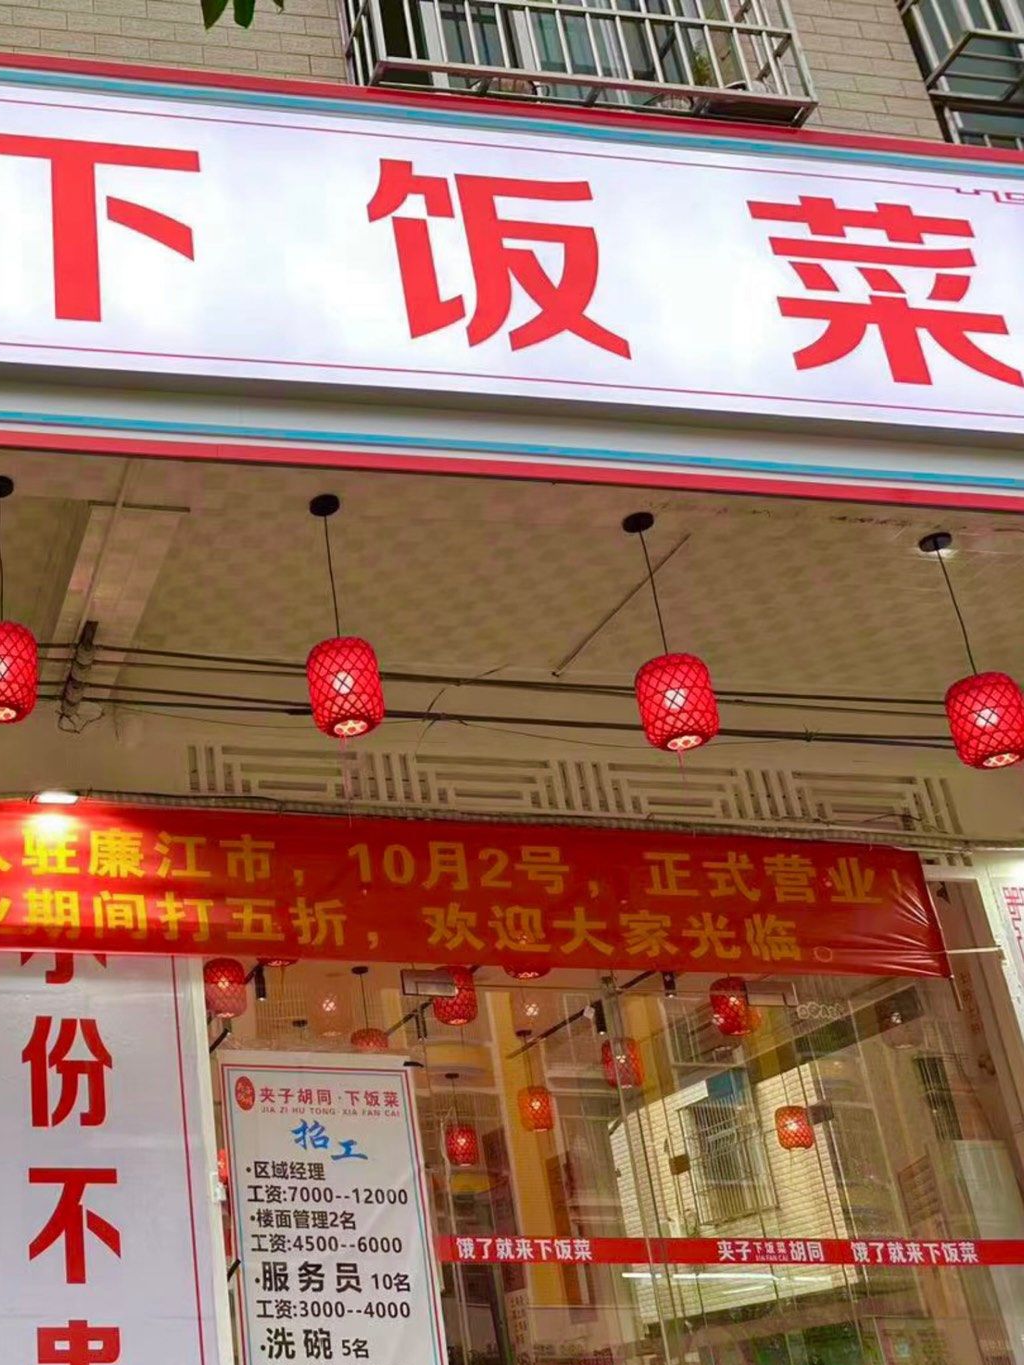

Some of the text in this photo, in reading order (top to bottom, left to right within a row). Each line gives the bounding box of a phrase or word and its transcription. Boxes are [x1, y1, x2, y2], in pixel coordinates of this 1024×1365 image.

[291, 1119, 369, 1161] 招工
[254, 1161, 326, 1181] 区域经理
[456, 1237, 593, 1260] 饿了就来下饭菜
[717, 1240, 751, 1262] 夹子
[789, 1240, 825, 1262] 胡同
[850, 1241, 979, 1264] 饿了就来下饭菜
[261, 1261, 412, 1293] 服务员 10名
[266, 1327, 370, 1361] 洗碗 5名
